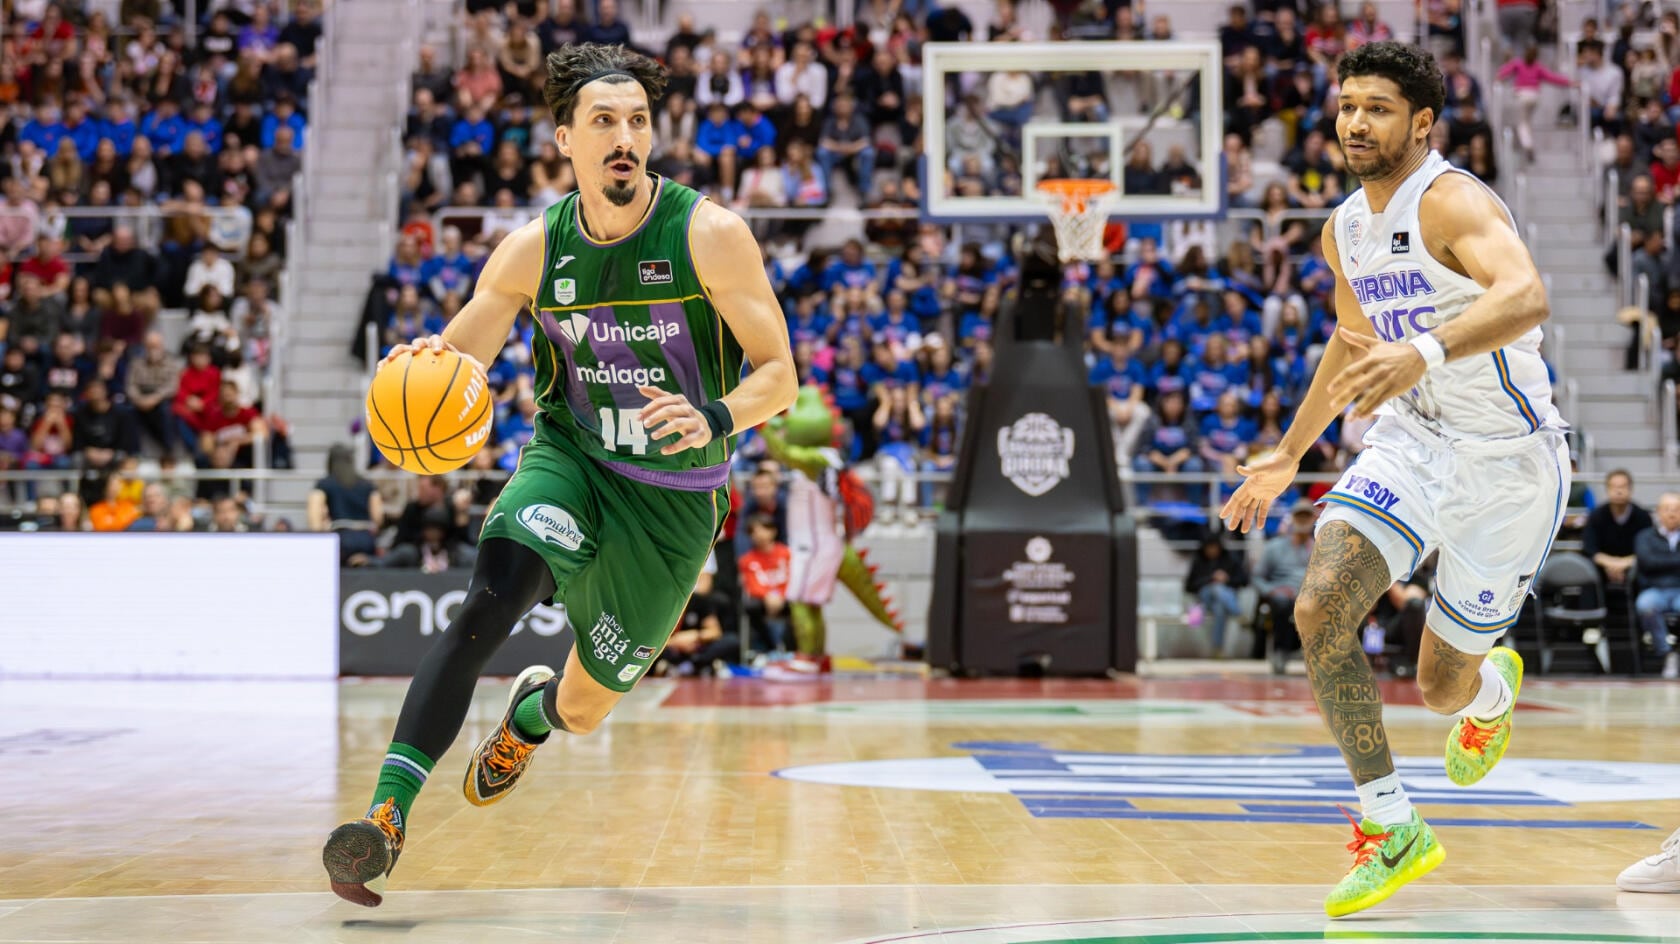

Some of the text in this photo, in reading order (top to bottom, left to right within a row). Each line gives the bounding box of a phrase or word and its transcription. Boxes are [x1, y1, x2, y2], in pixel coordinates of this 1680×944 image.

[592, 320, 681, 344] Unicaja
[599, 407, 649, 455] 14
[1345, 474, 1401, 511] YOSOY
[341, 579, 567, 637] ens
[1342, 722, 1385, 754] 680
